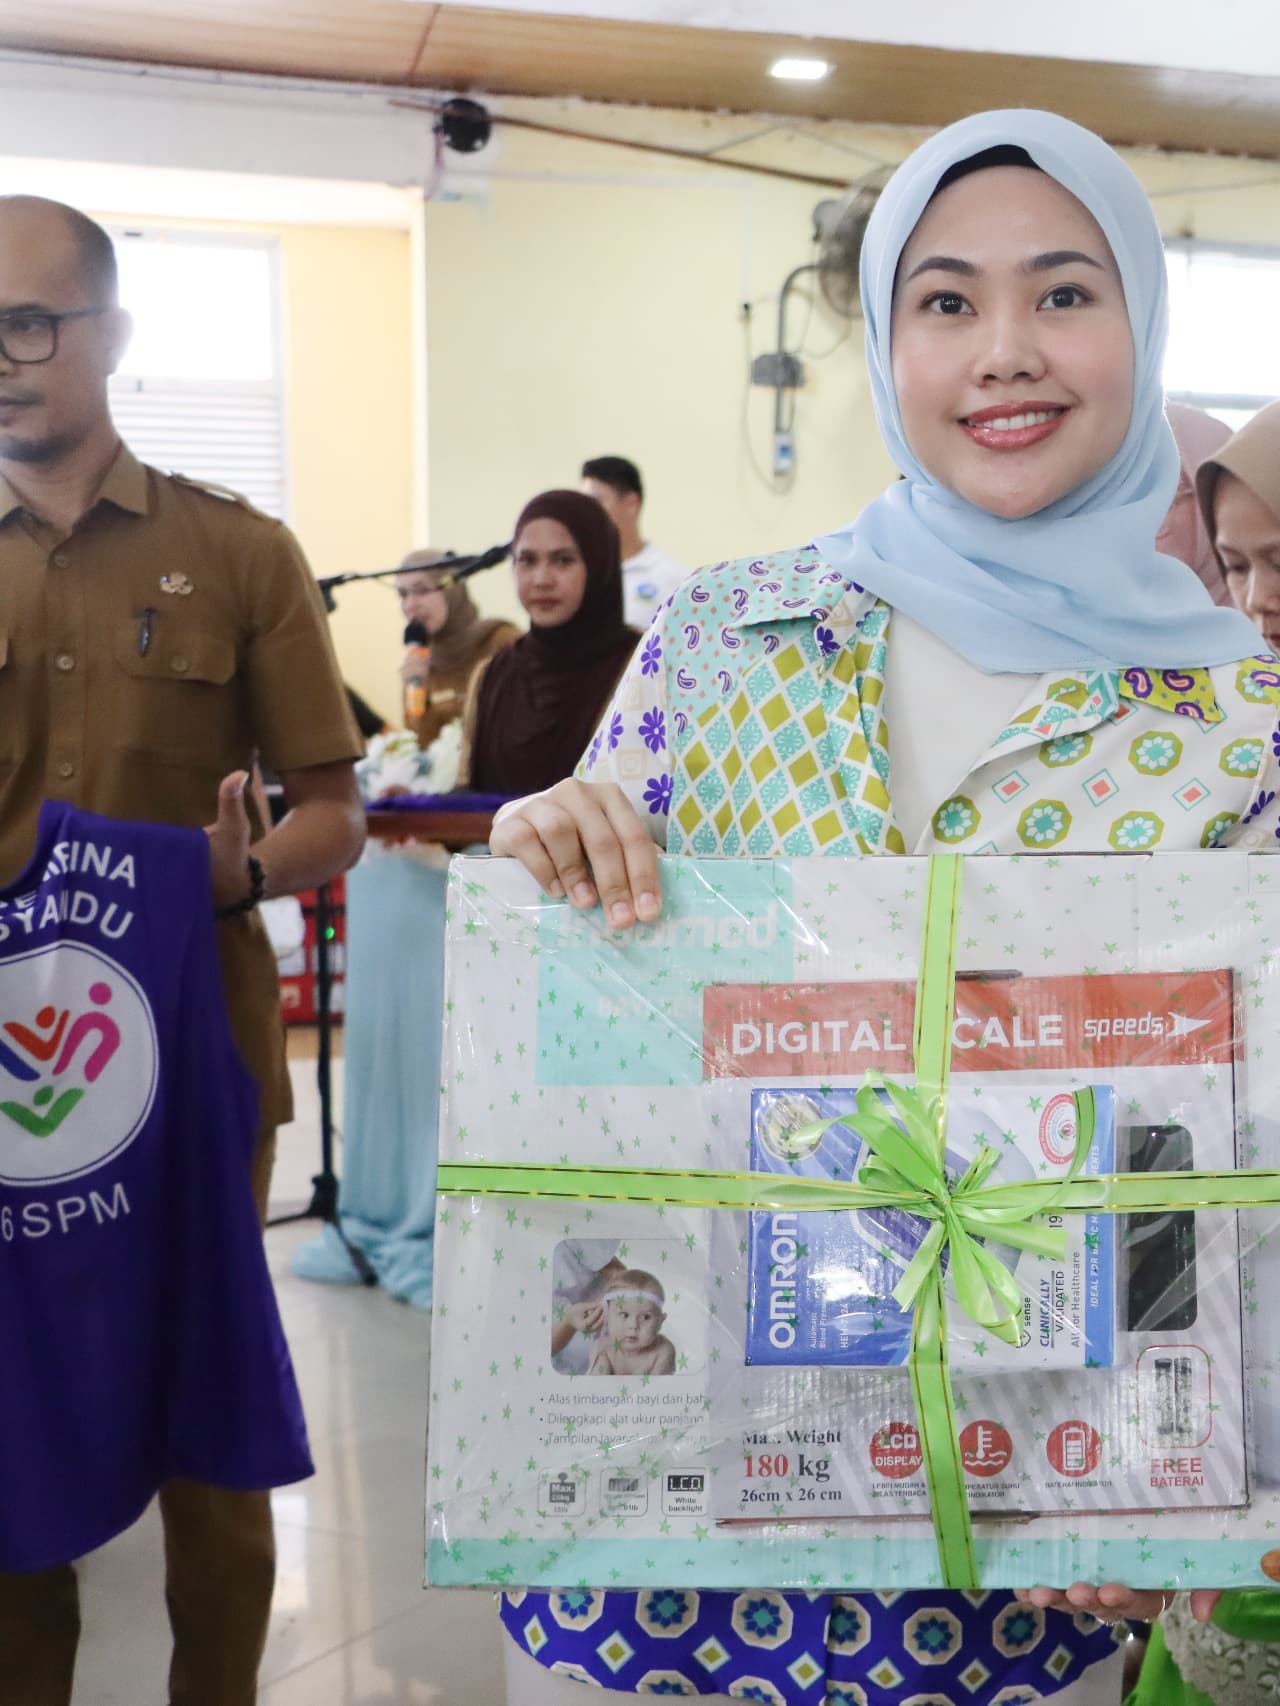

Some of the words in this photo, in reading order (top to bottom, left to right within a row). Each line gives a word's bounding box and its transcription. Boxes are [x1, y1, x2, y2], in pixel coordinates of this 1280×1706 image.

[732, 1020, 906, 1055] DIGITAL
[951, 1014, 1064, 1049] CALE
[1083, 1012, 1165, 1042] speeds
[21, 1181, 131, 1238] SPM
[1071, 1251, 1080, 1310] Healthcare
[1090, 1279, 1099, 1307] IDEAL
[1056, 1271, 1065, 1332] VALIDATED
[1040, 1279, 1050, 1347] CLINICALLY
[1071, 1314, 1080, 1330] or
[632, 1414, 656, 1424] ukur
[787, 1430, 841, 1445] Weight
[879, 1433, 917, 1449] LCD
[744, 1454, 789, 1478] 180
[798, 1454, 831, 1482] kg
[875, 1456, 923, 1466] DISPLAY
[1151, 1457, 1203, 1473] FREE
[1150, 1475, 1204, 1487] BATERAI
[741, 1489, 785, 1502] 26cm
[785, 1492, 794, 1502] x
[799, 1488, 816, 1501] 26
[820, 1490, 843, 1501] cm
